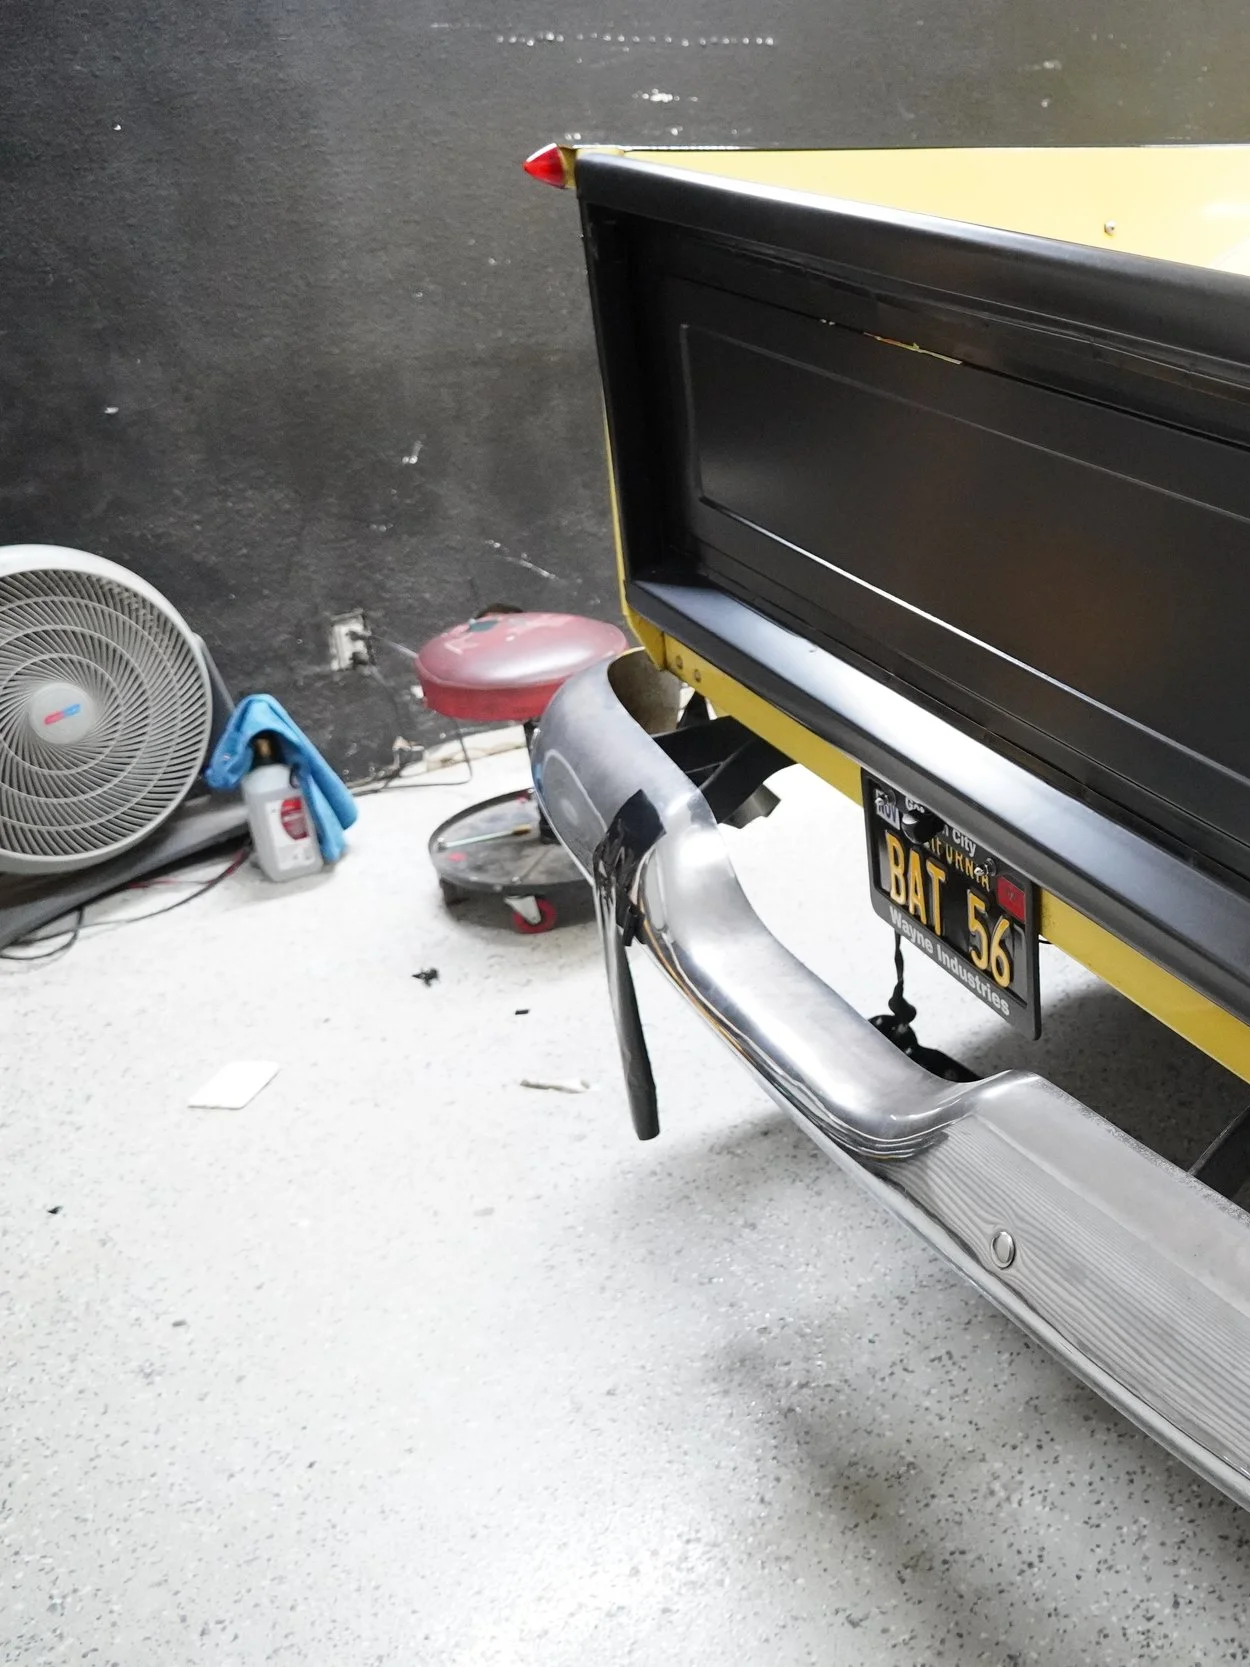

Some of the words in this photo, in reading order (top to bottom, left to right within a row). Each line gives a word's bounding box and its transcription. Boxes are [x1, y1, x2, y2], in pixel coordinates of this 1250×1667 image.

[952, 828, 976, 857] City
[886, 831, 946, 936] BAT
[967, 889, 1010, 987] 56
[890, 905, 933, 953] Wayne
[937, 944, 1010, 1016] Industries
